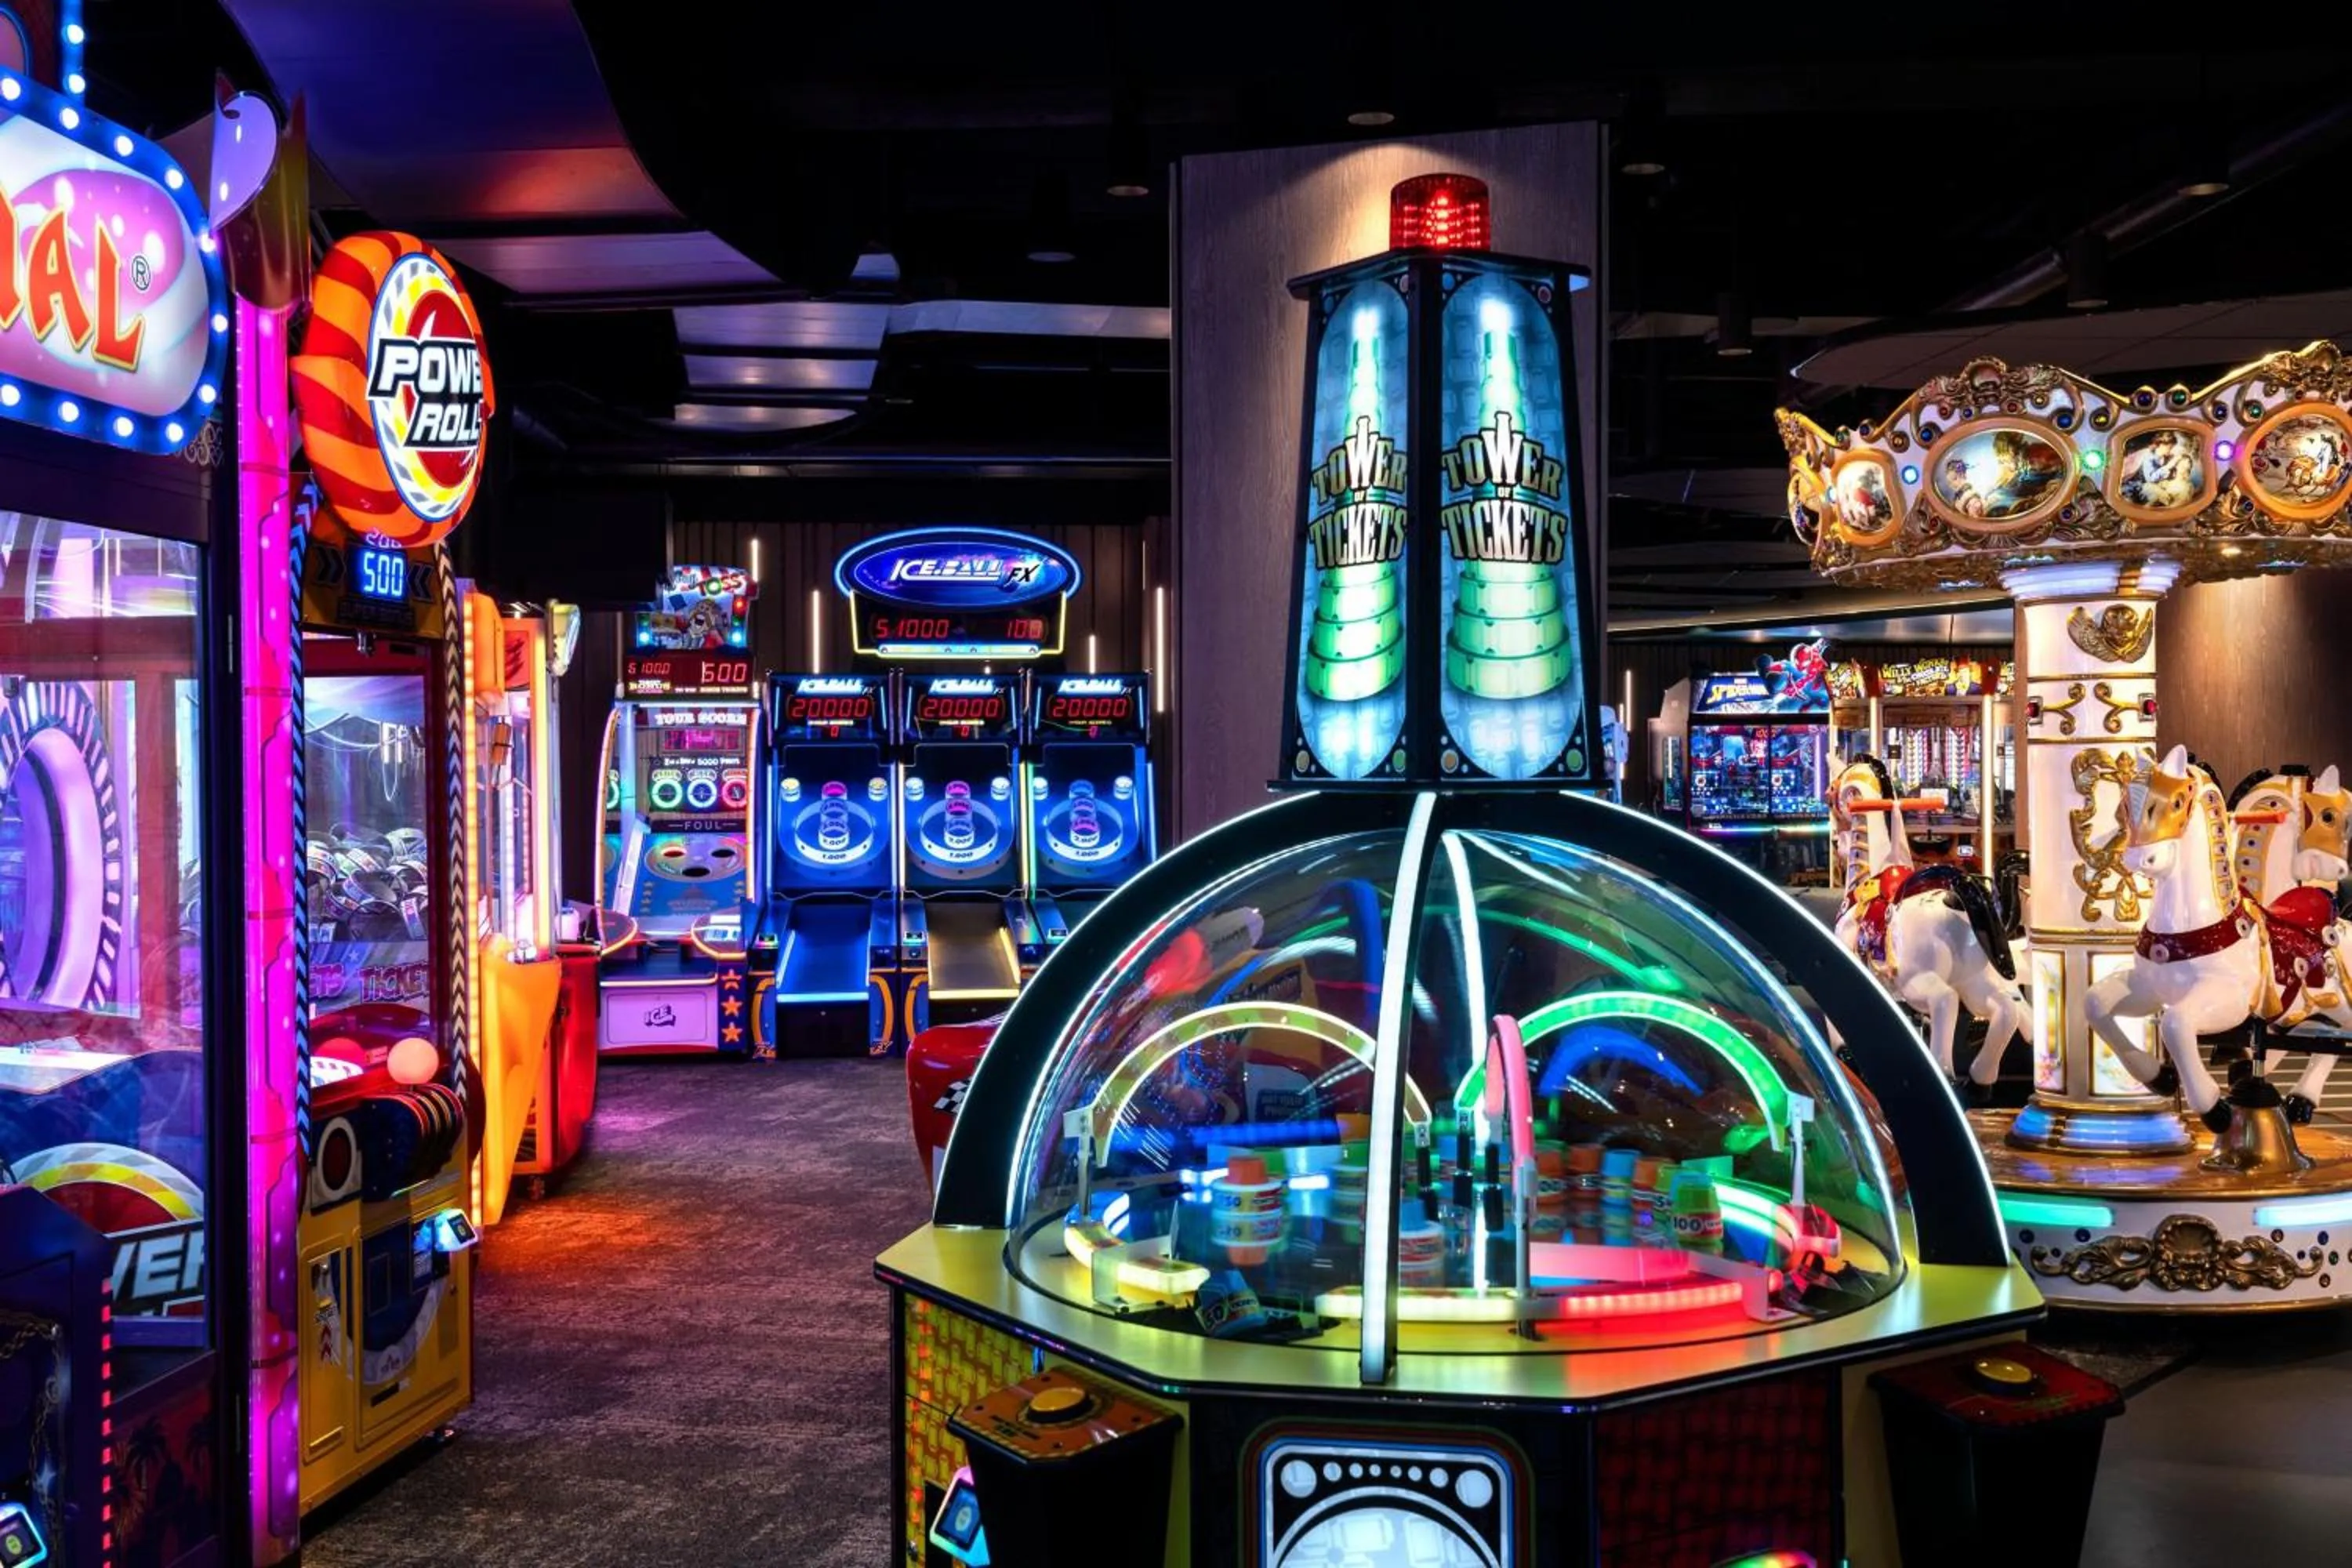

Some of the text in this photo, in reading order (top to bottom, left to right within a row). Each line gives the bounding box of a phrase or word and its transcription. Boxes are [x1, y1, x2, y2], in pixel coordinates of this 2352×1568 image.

[377, 345, 483, 393] POWE
[1312, 416, 1408, 503] TOWER
[1441, 411, 1563, 499] TOWER
[1308, 502, 1408, 570] TICKETS
[1440, 498, 1566, 564] TICKETS
[362, 551, 405, 597] 500
[791, 699, 869, 717] 20000
[924, 699, 1000, 717] 20000
[1053, 699, 1127, 717] 20000
[684, 821, 722, 829] FOUL
[1673, 1216, 1700, 1232] 100
